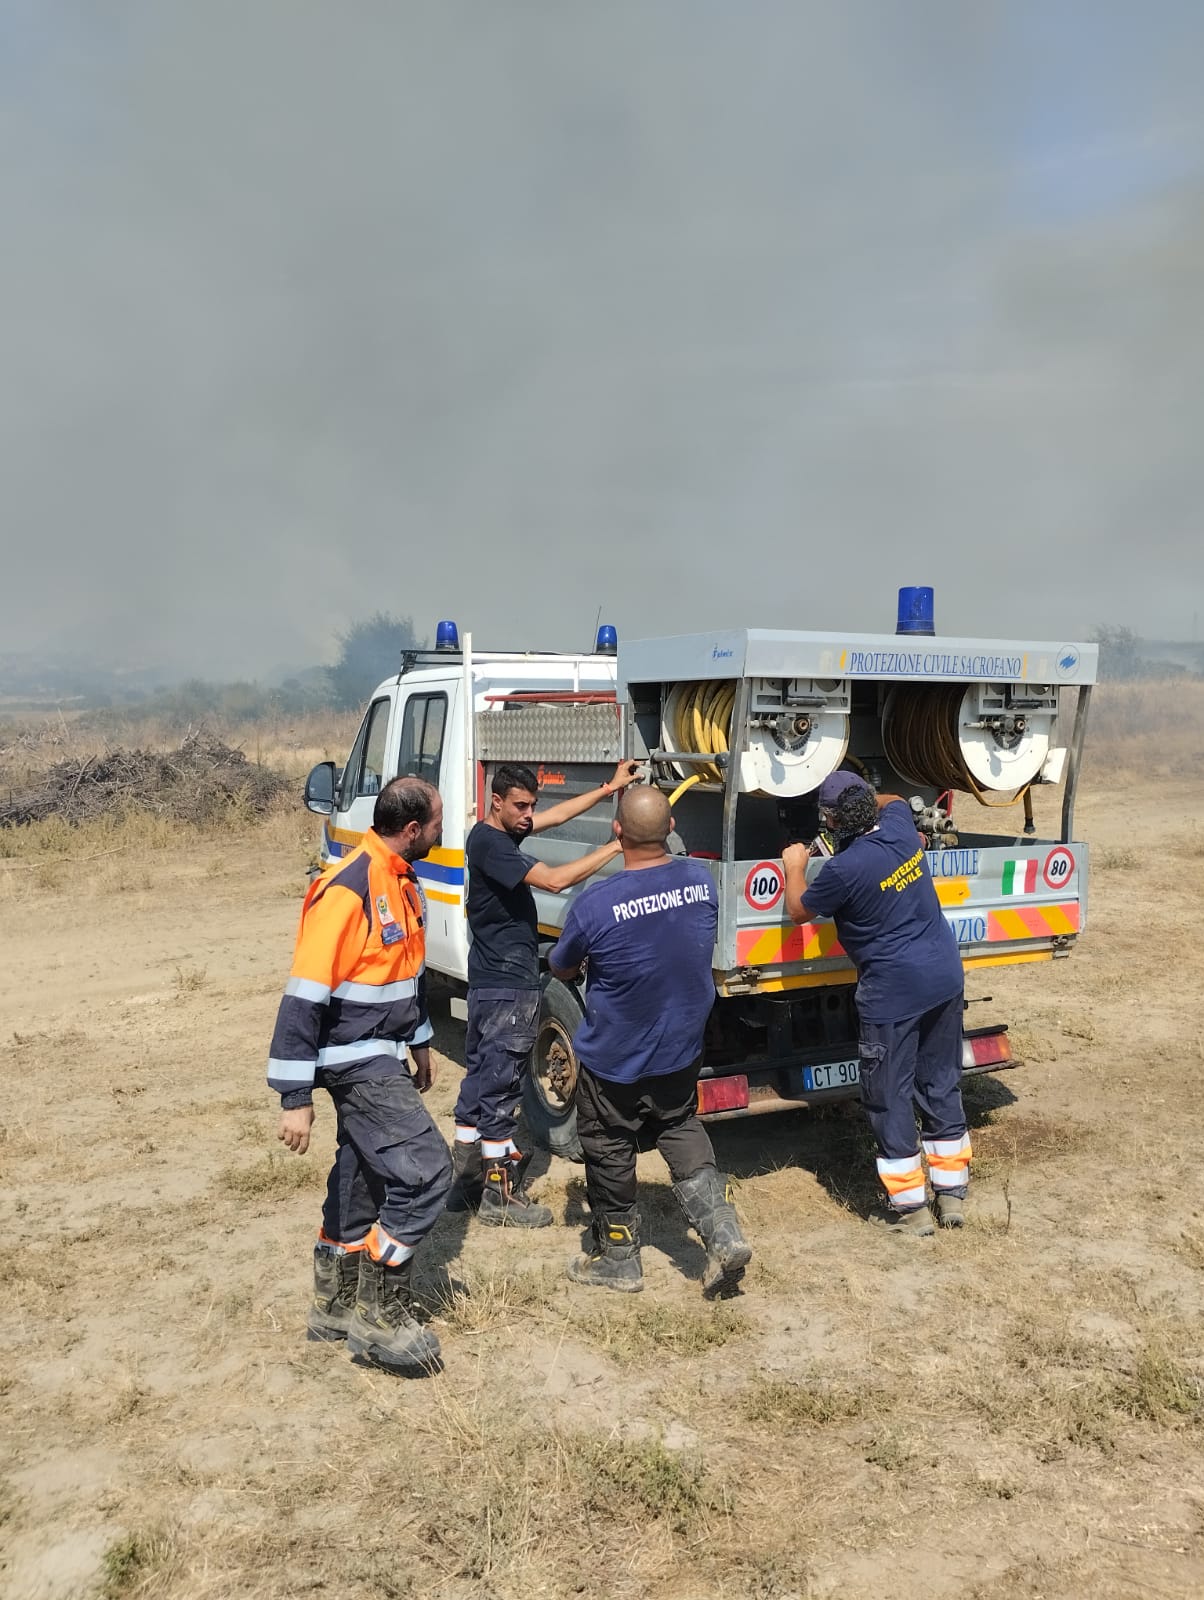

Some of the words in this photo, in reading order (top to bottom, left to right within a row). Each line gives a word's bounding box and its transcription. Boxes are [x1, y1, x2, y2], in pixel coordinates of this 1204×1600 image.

[850, 652, 922, 673] PROTEZIONE
[923, 655, 959, 674] CIVILE
[960, 655, 1021, 677] SACROFANO
[880, 847, 924, 891] PROTEZIONE
[942, 850, 978, 877] CIVILE
[1051, 860, 1067, 876] 80
[752, 876, 778, 896] 100
[895, 866, 923, 892] CIVILE
[612, 888, 684, 922] PROTEZIONE
[683, 883, 710, 904] CIVILE
[814, 1066, 831, 1087] CT
